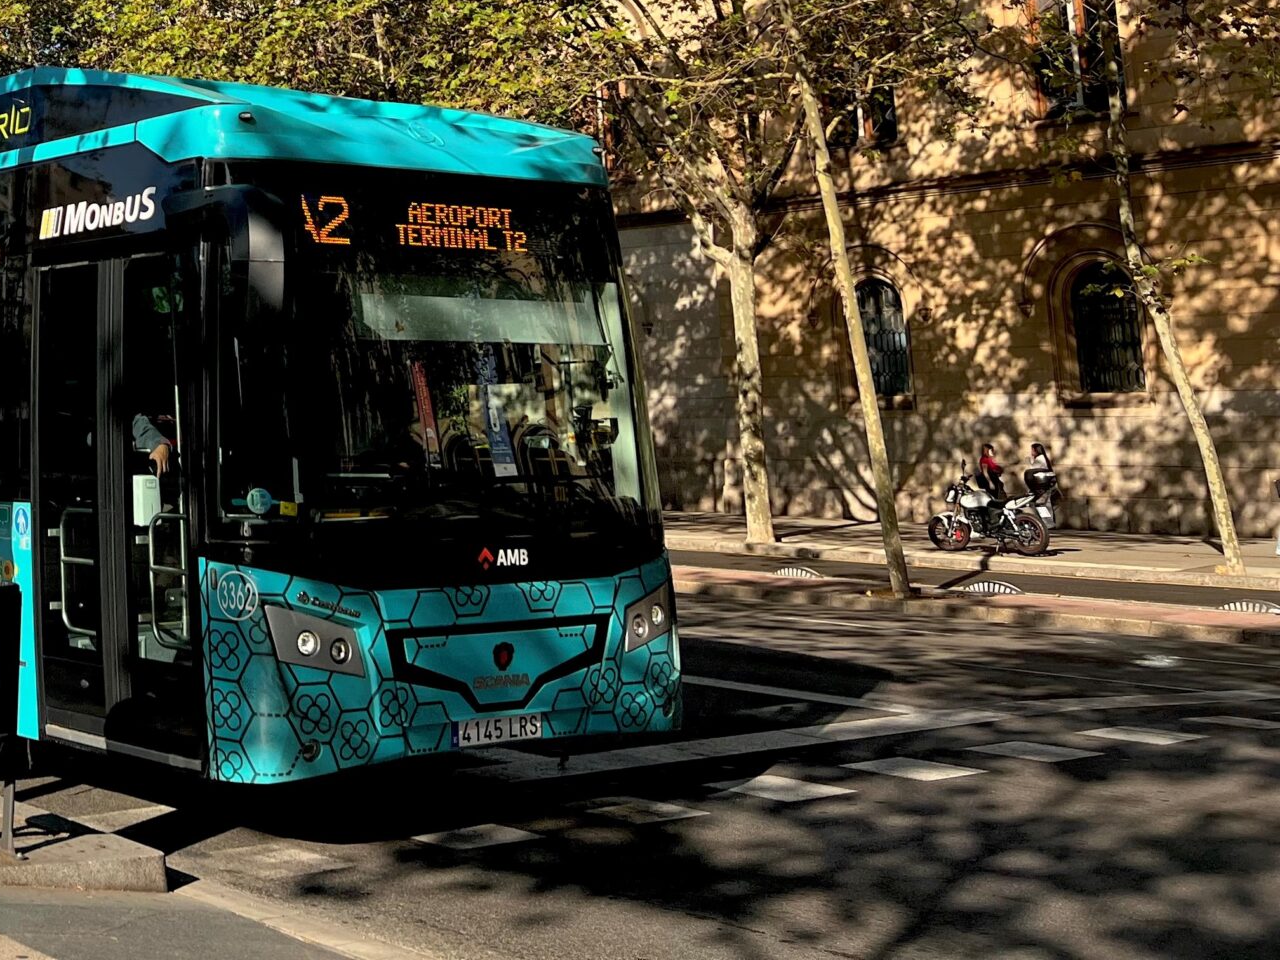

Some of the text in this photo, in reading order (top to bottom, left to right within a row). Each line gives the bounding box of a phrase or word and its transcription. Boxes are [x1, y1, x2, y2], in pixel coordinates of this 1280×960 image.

[63, 186, 156, 235] MONBUS
[408, 202, 512, 228] AEROPORT
[395, 224, 528, 252] TERMINAL T2
[496, 548, 528, 566] AMB
[221, 580, 254, 611] 3362
[473, 673, 530, 689] SCANIA
[462, 715, 538, 743] 4145 LRS
